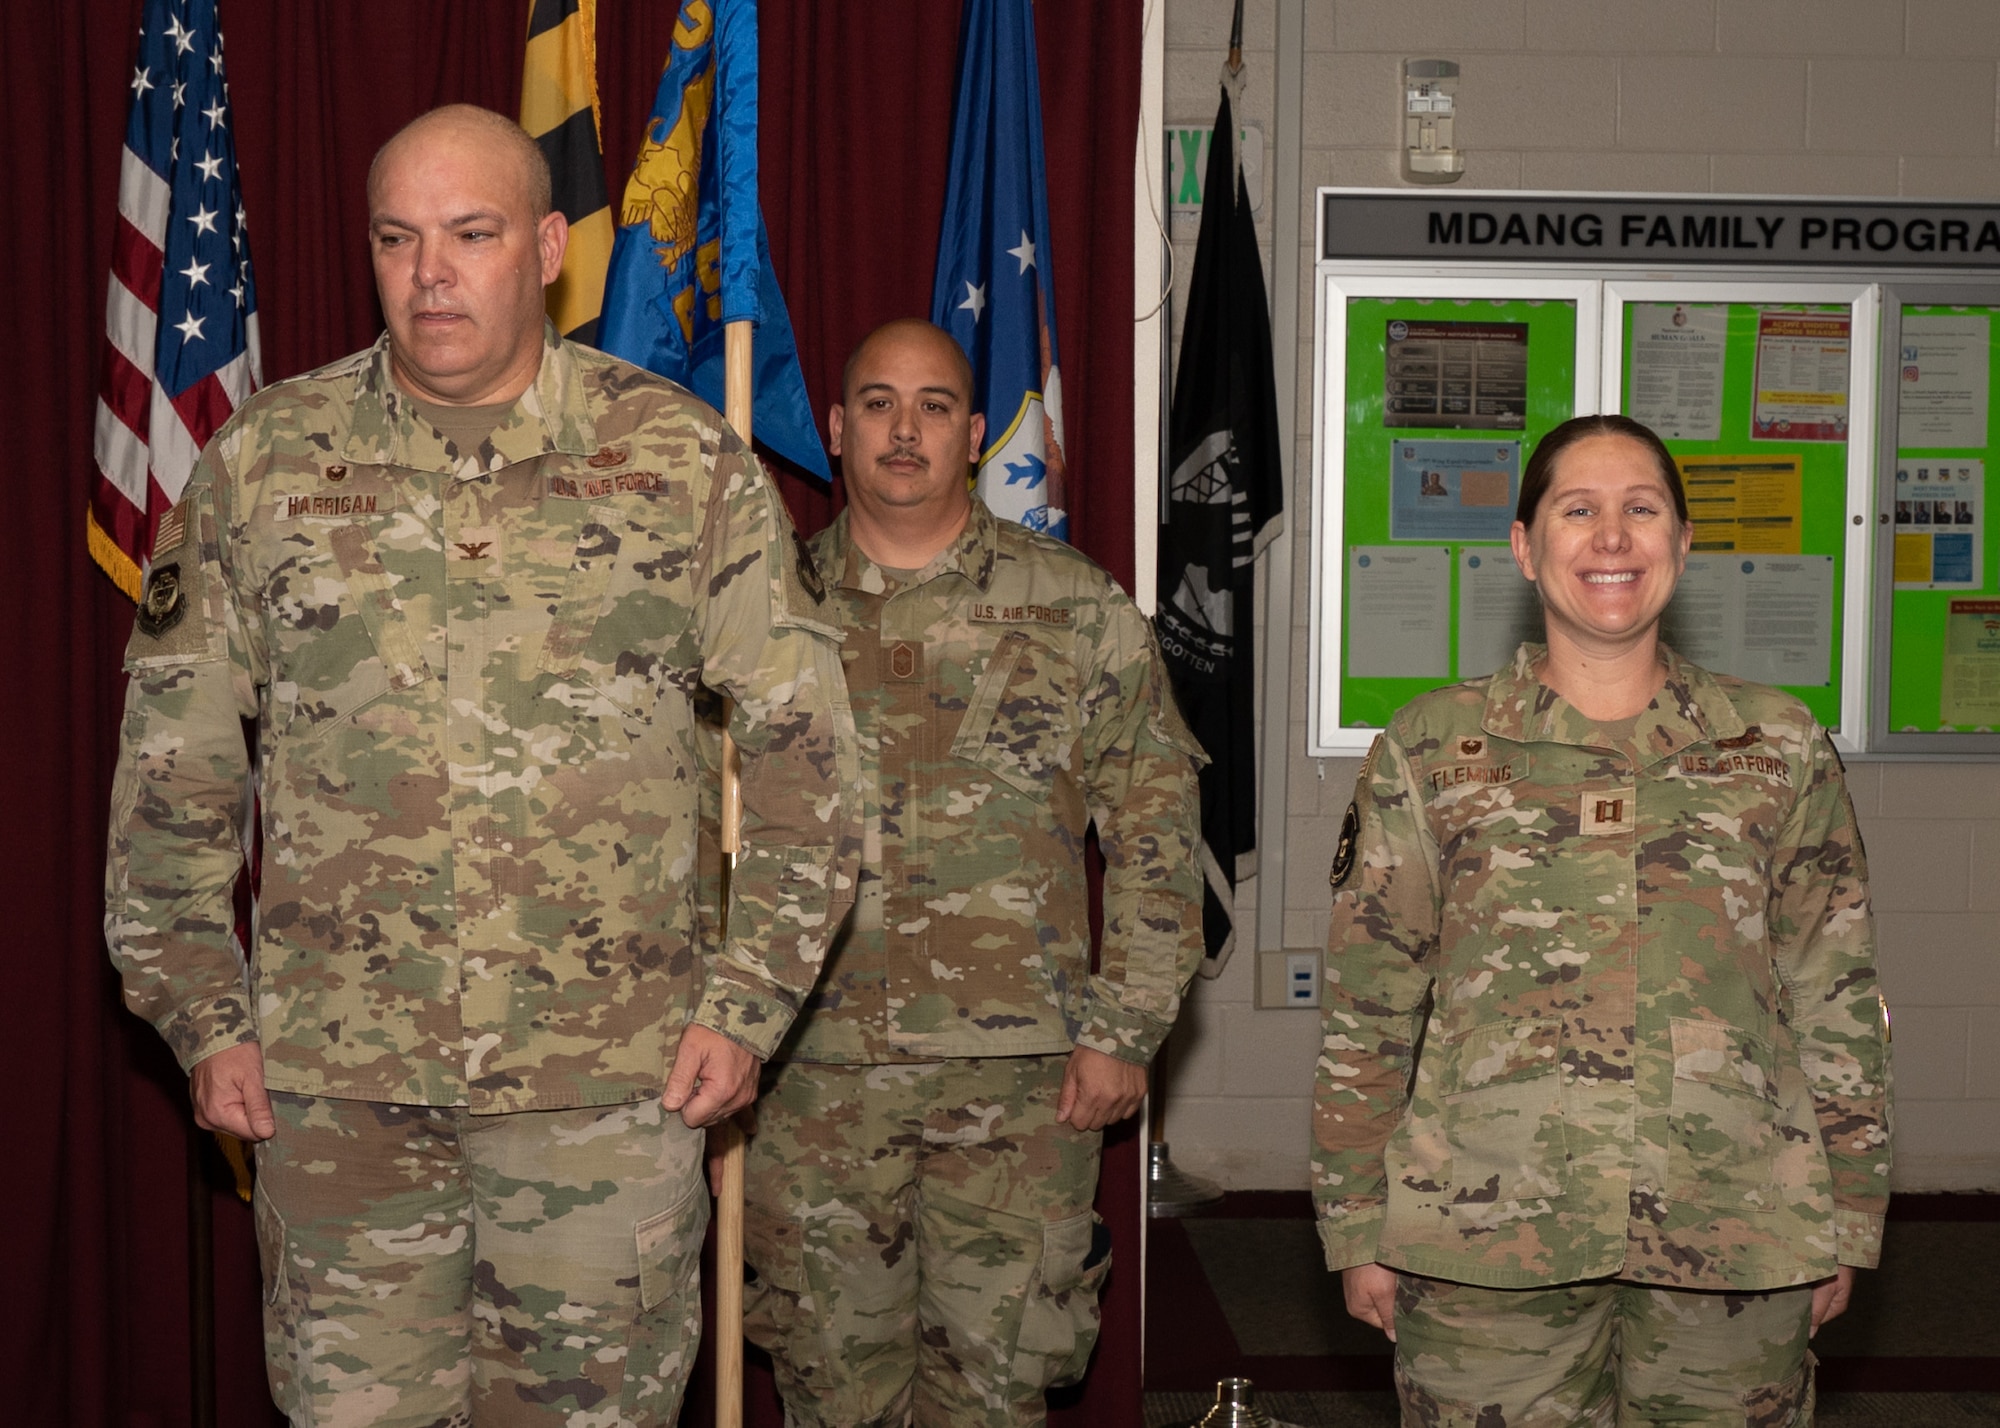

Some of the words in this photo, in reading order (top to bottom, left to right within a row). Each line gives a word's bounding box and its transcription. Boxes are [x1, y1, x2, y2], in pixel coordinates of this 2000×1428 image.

[1428, 211, 1602, 247] MDANG
[1620, 214, 1785, 249] FAMILY
[1800, 217, 2000, 253] PROGRA
[614, 472, 664, 493] FORCE
[287, 495, 377, 517] HARRIGAN
[974, 604, 997, 620] U.S.
[1002, 606, 1023, 620] AIR
[1028, 605, 1069, 624] FORCE
[1432, 764, 1512, 791] FLEMING
[1684, 755, 1713, 773] U.S.
[1717, 755, 1745, 773] AIR
[1746, 754, 1790, 782] FORCE
